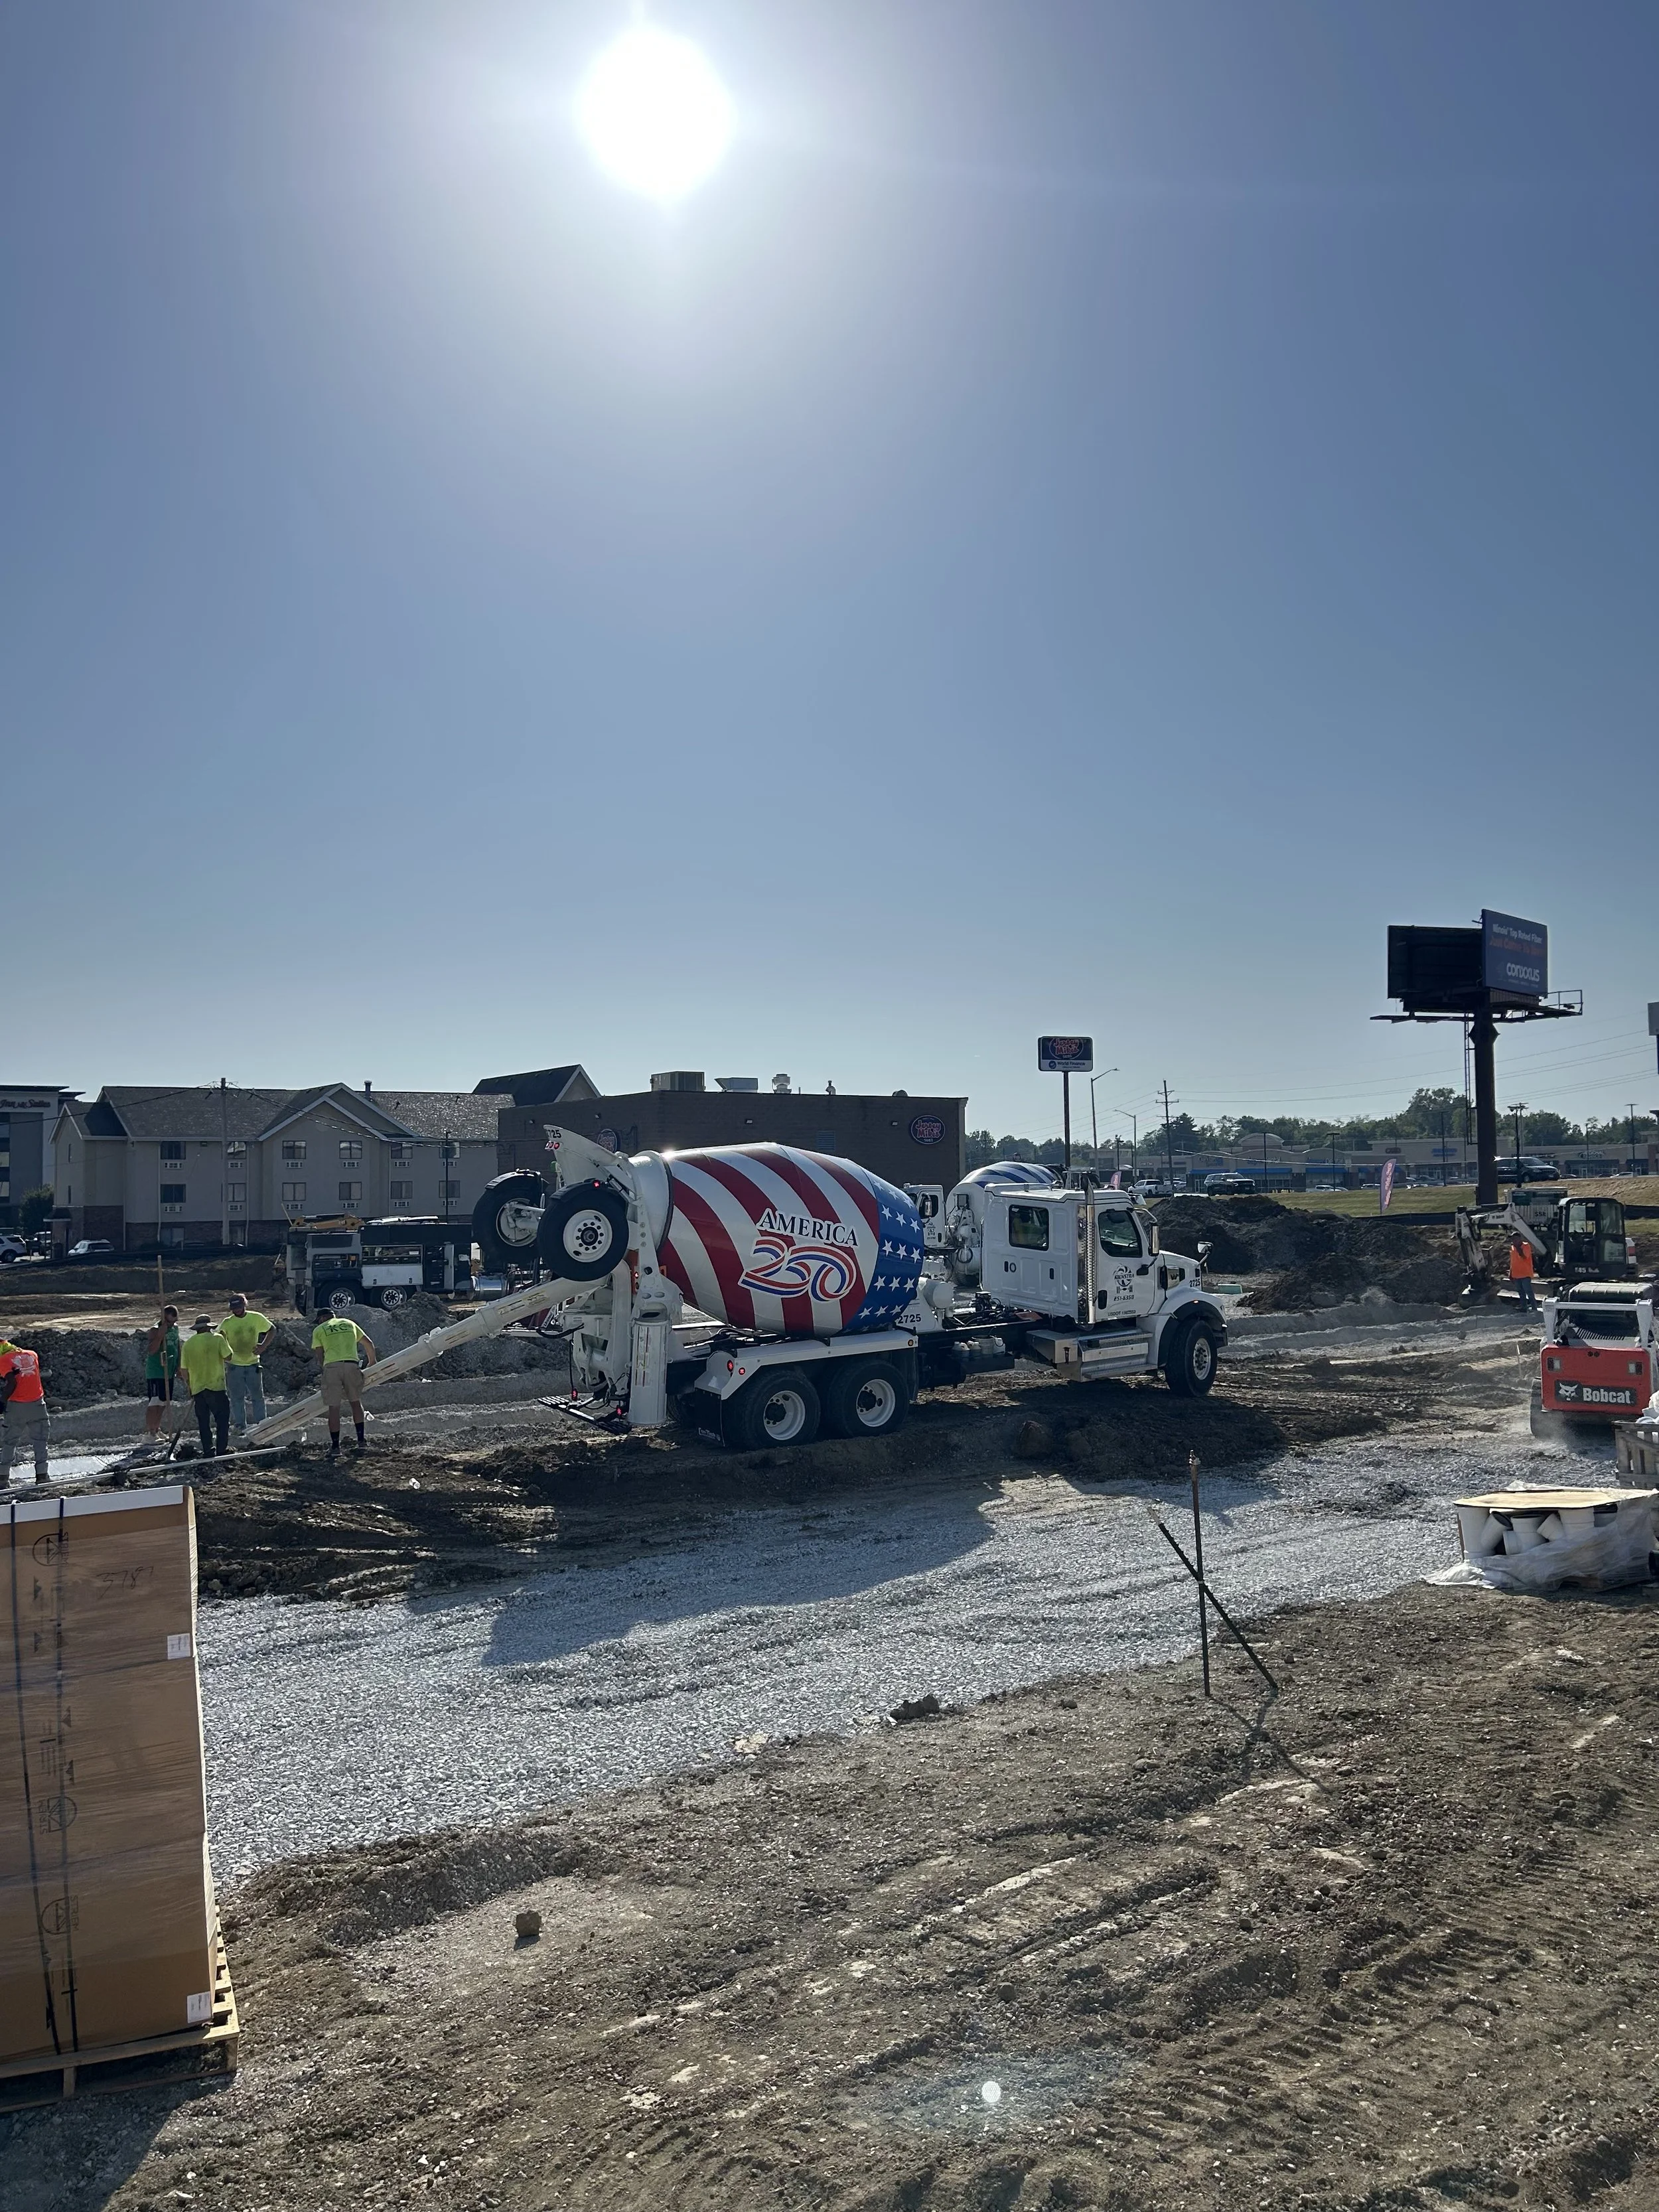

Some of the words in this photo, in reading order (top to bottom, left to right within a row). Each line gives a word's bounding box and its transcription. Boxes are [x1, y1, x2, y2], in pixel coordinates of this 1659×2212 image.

[1053, 1037, 1080, 1047] Jersey
[916, 1120, 941, 1131] Jersey
[545, 1129, 562, 1139] 725
[758, 1211, 858, 1247] AMERICA
[1189, 1279, 1200, 1288] 2725
[898, 1313, 922, 1324] 2725
[1583, 1387, 1631, 1404] Bobcat
[38, 1799, 47, 1835] STRIEM
[70, 1895, 79, 1931] STRIEM
